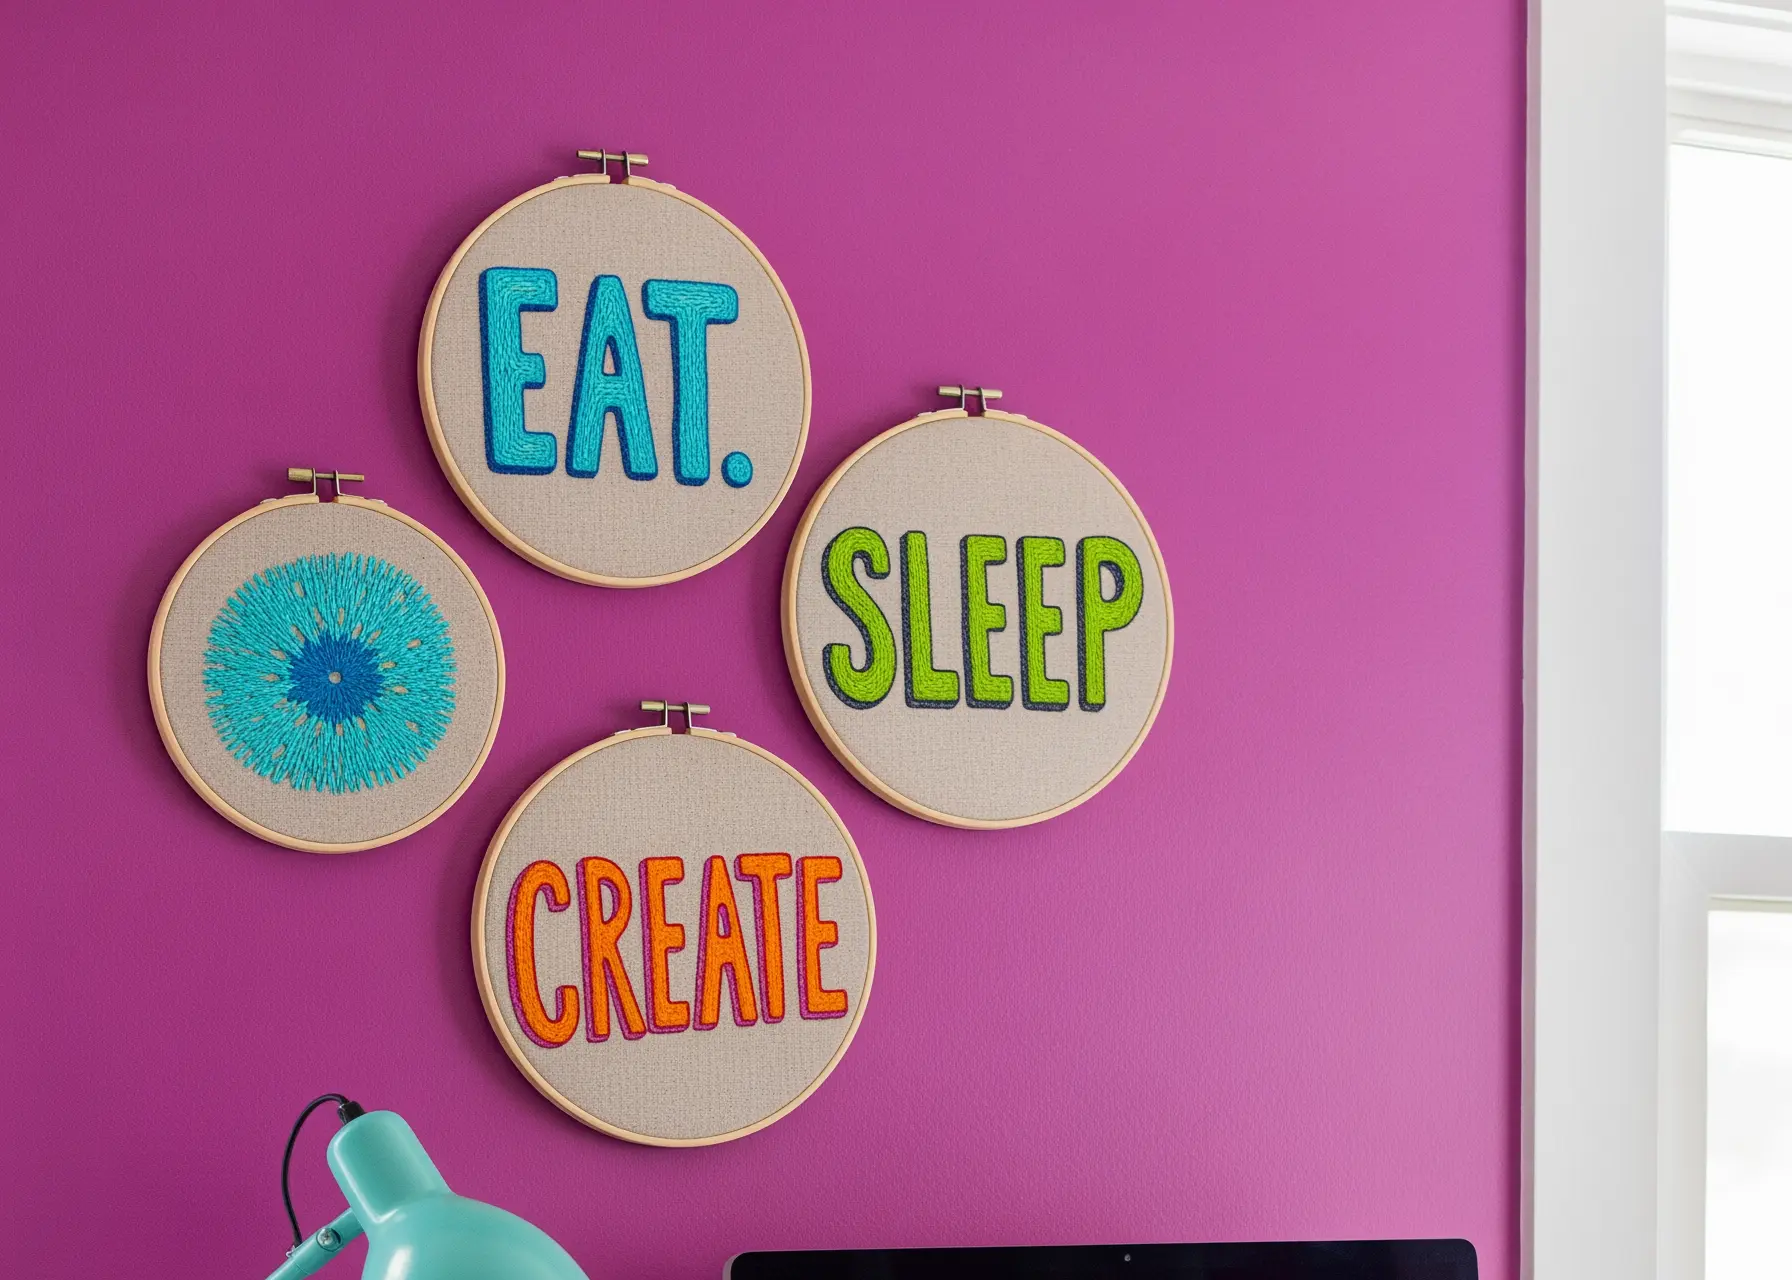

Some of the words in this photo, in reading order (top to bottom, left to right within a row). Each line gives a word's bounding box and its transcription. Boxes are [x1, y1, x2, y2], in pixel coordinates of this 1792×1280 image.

[479, 267, 753, 488] EAT.
[821, 526, 1144, 712] SLEEP
[506, 853, 848, 1048] CREATE
